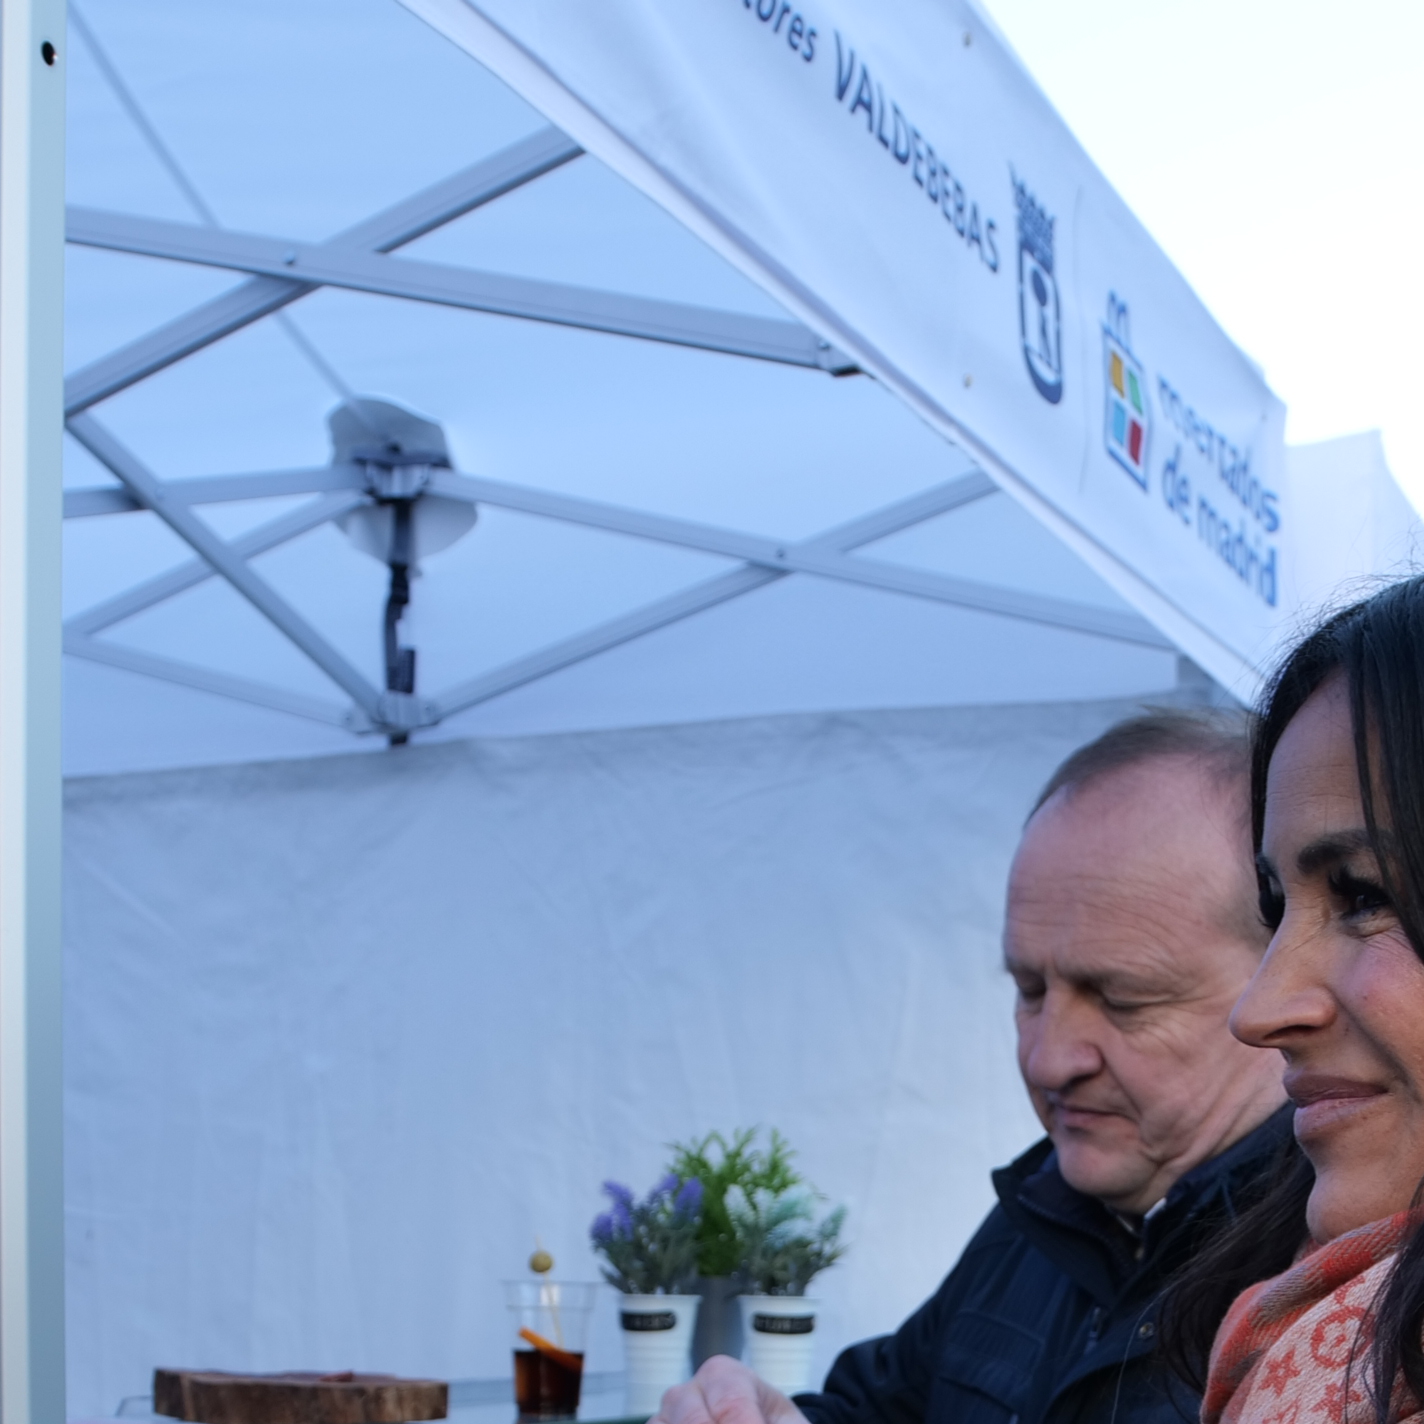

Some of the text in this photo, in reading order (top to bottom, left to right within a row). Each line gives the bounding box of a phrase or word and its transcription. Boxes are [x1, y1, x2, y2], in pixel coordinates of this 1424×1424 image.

[833, 27, 1000, 273] VALDEBEBAS
[1161, 441, 1278, 610] de madrid
